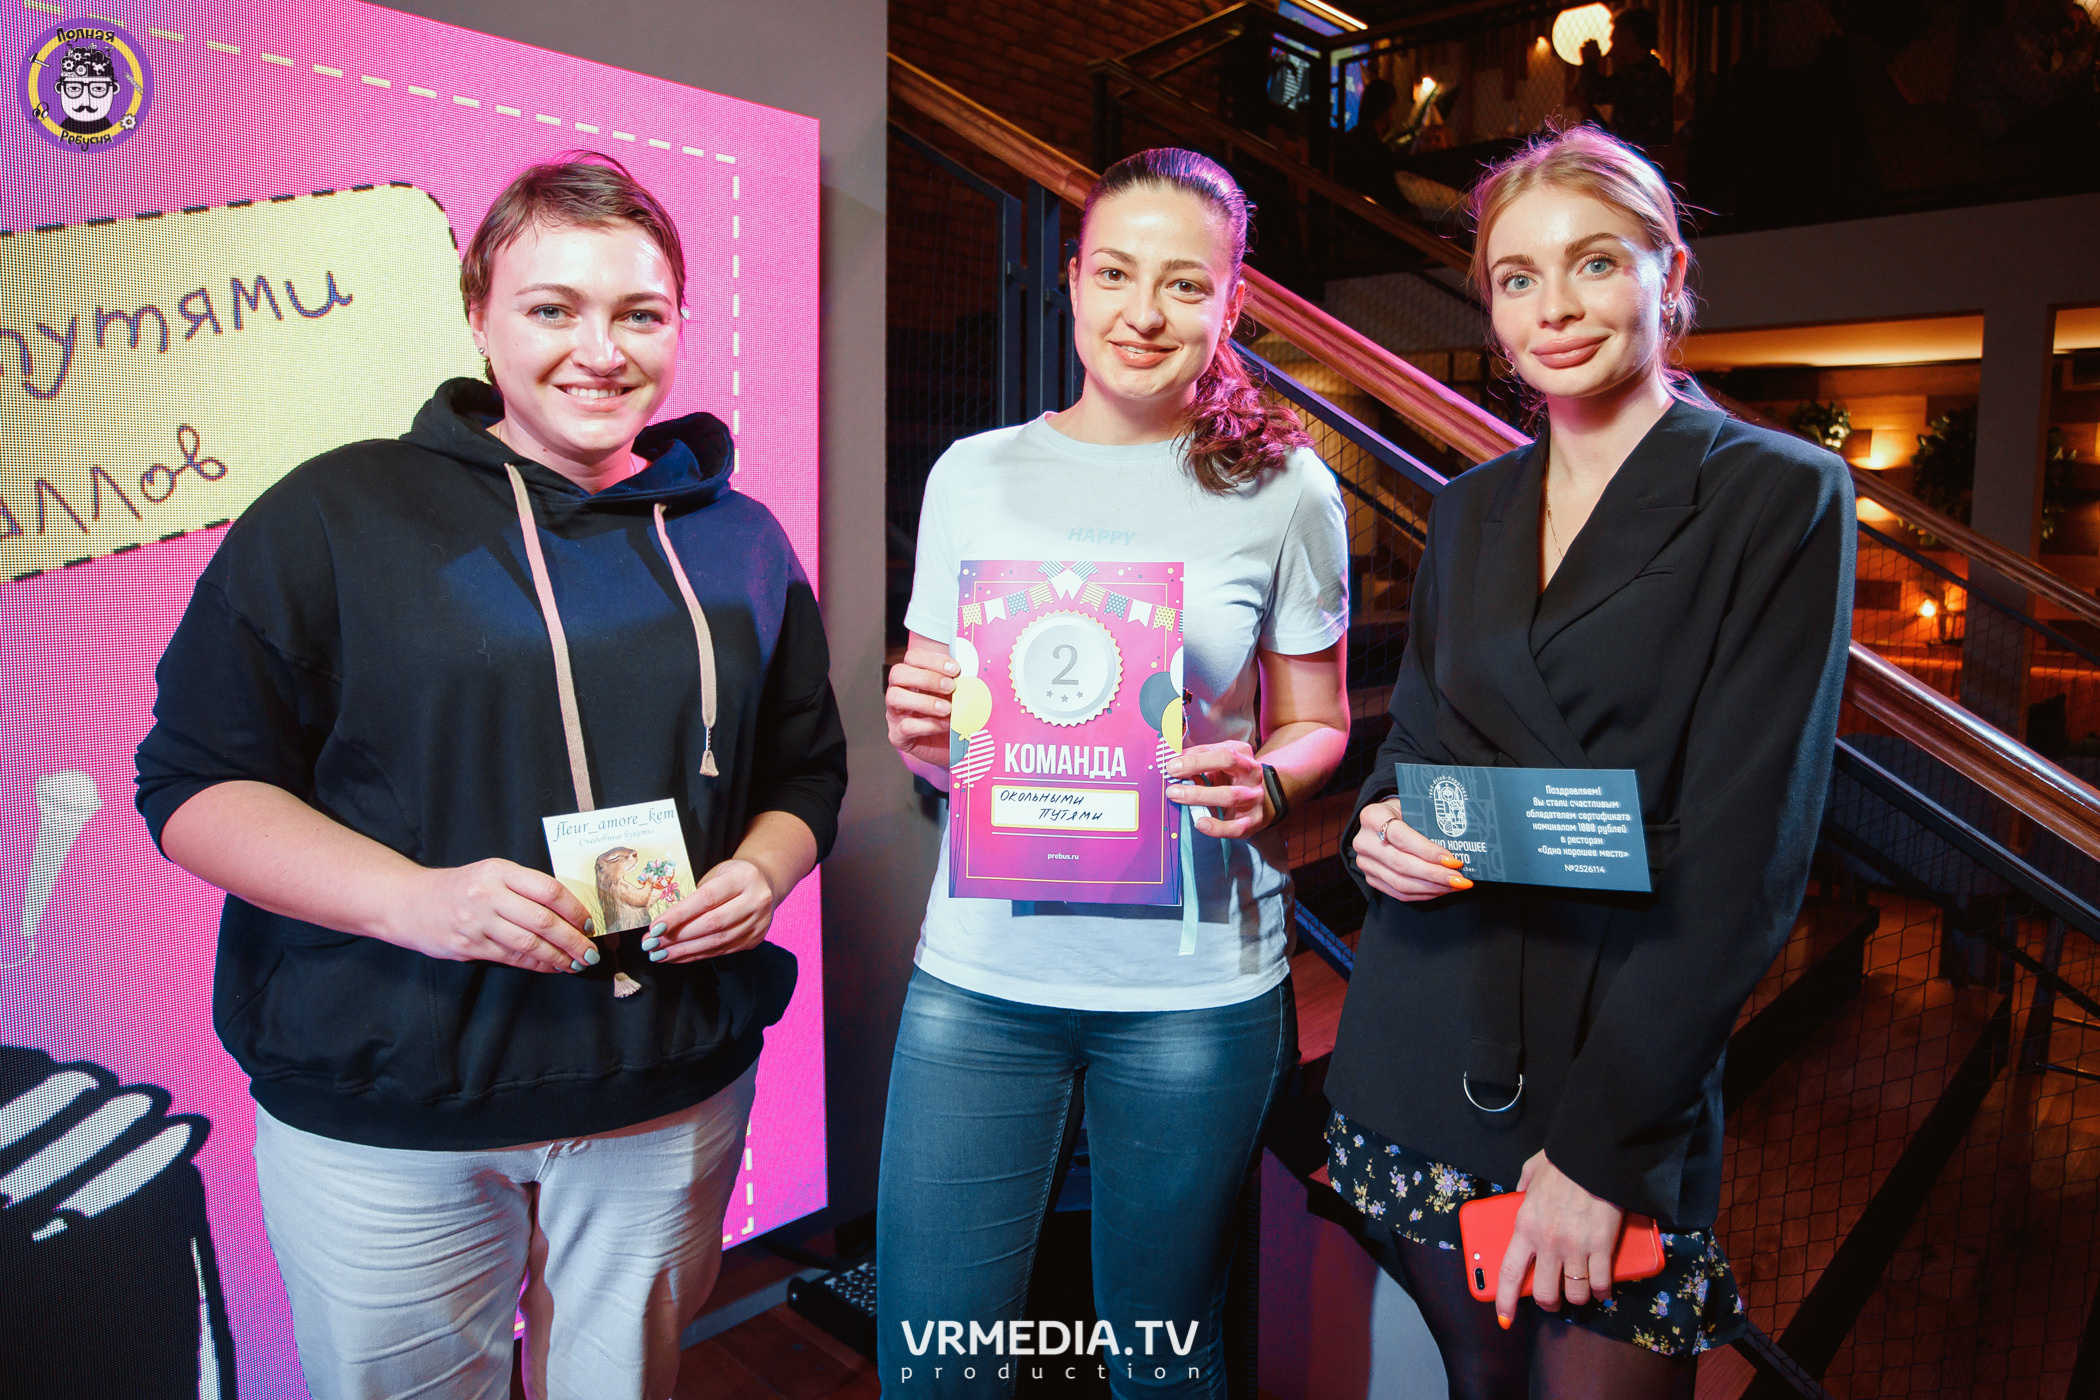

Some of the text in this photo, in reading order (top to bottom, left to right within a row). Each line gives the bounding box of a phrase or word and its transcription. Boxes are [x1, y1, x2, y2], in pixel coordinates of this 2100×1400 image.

[1068, 528, 1137, 545] HAPPY
[1051, 643, 1080, 686] 2
[1003, 742, 1128, 779] КОМАНДА
[1000, 790, 1085, 805] ОКОЛЬНЫМИ
[1545, 785, 1602, 797] Поздравляем!
[1532, 797, 1620, 809] Вы стали счастливым
[1039, 808, 1103, 821] ПУТЯМИ
[1525, 809, 1631, 822] обладателем сертификата
[553, 807, 674, 842] fleur_amore_kem
[1532, 823, 1577, 832] номиналом
[1597, 824, 1627, 835] рублей
[1447, 840, 1487, 853] ХОРОШЕЕ
[1567, 837, 1604, 846] ресторан
[1047, 852, 1080, 862] prebus.ru
[1537, 845, 1629, 858] «Одно хорошее место»
[1564, 864, 1606, 873] №2526114
